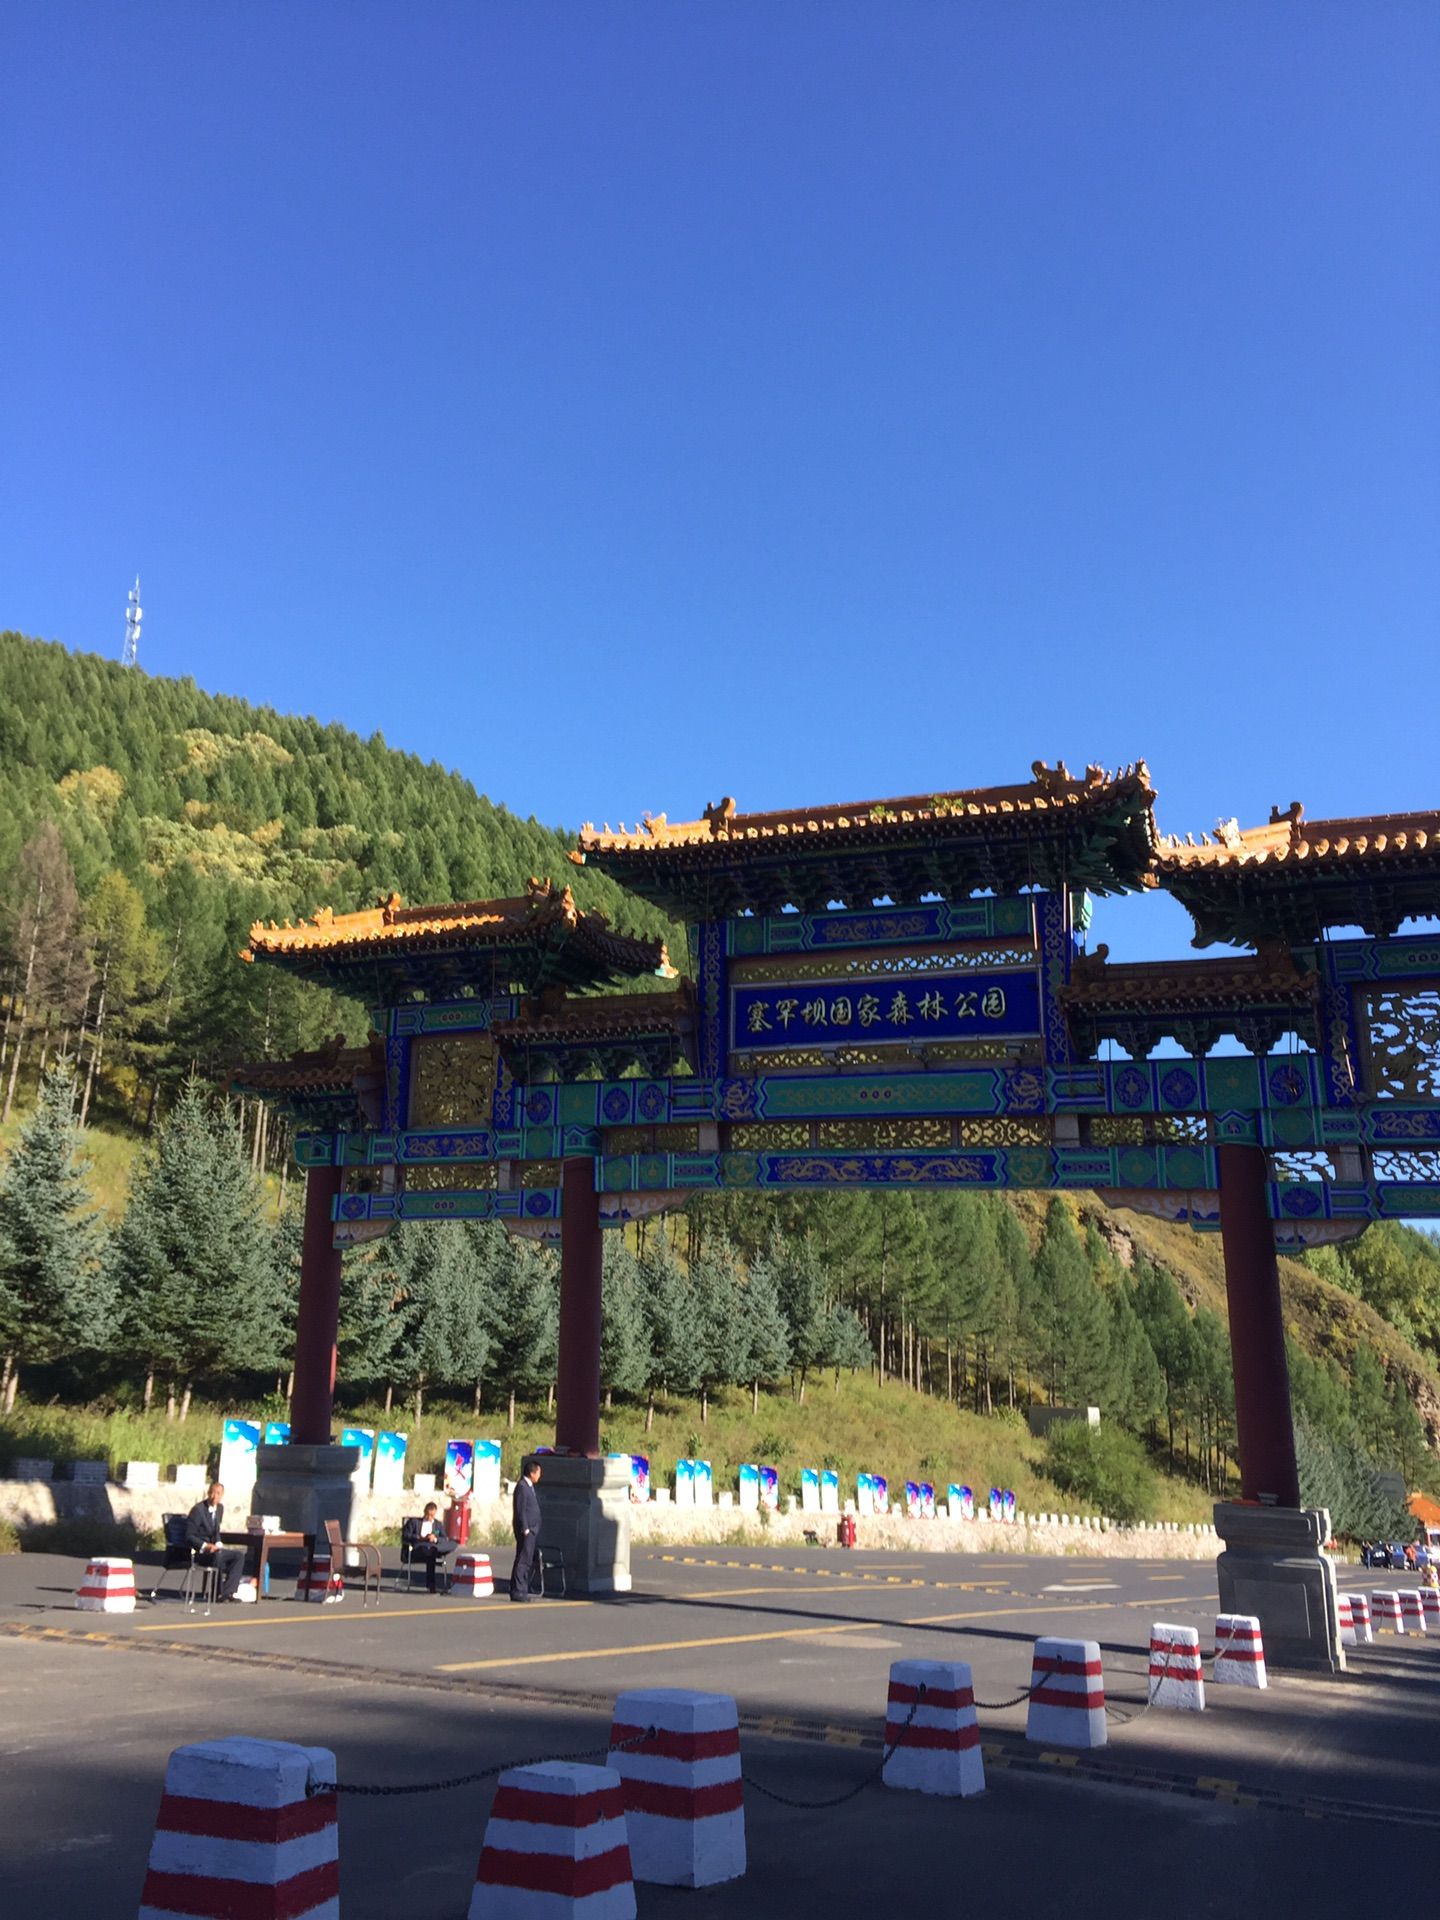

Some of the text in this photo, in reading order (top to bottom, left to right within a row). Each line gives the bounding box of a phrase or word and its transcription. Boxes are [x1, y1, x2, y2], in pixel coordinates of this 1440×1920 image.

[747, 987, 1005, 1032] 塞罕坝国家森林公园
